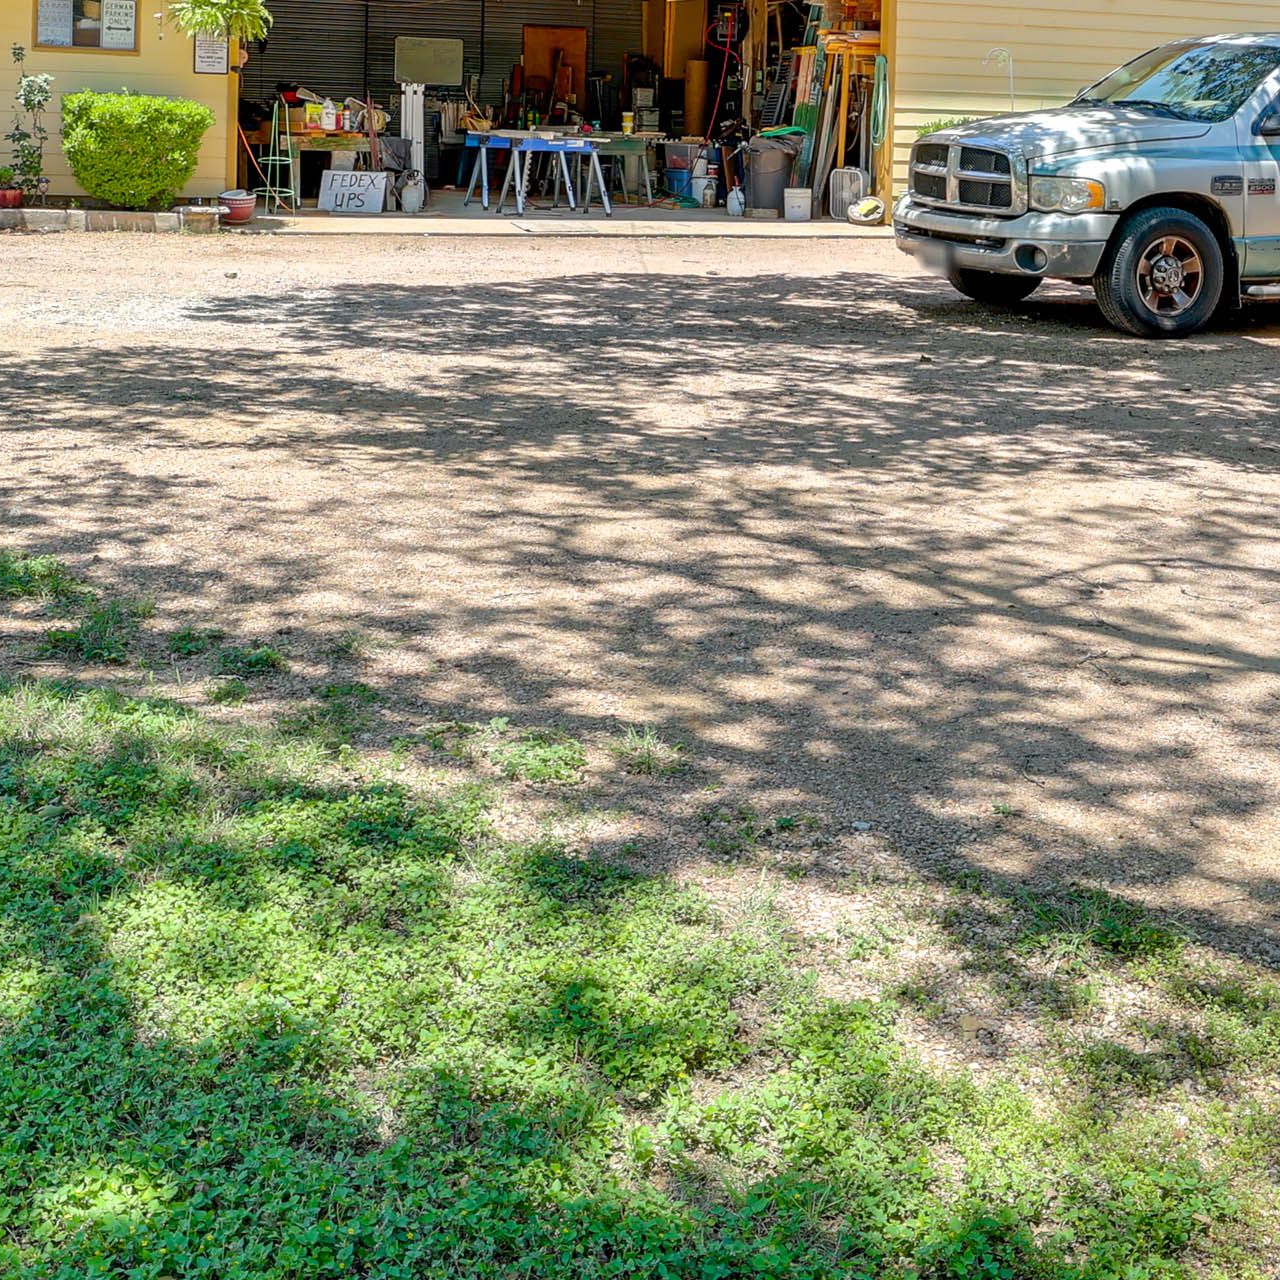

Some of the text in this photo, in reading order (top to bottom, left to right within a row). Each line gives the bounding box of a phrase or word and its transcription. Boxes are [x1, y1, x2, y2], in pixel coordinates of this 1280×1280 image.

[108, 17, 129, 25] ONLY
[328, 173, 380, 191] FEDEX
[334, 192, 367, 208] UPS
